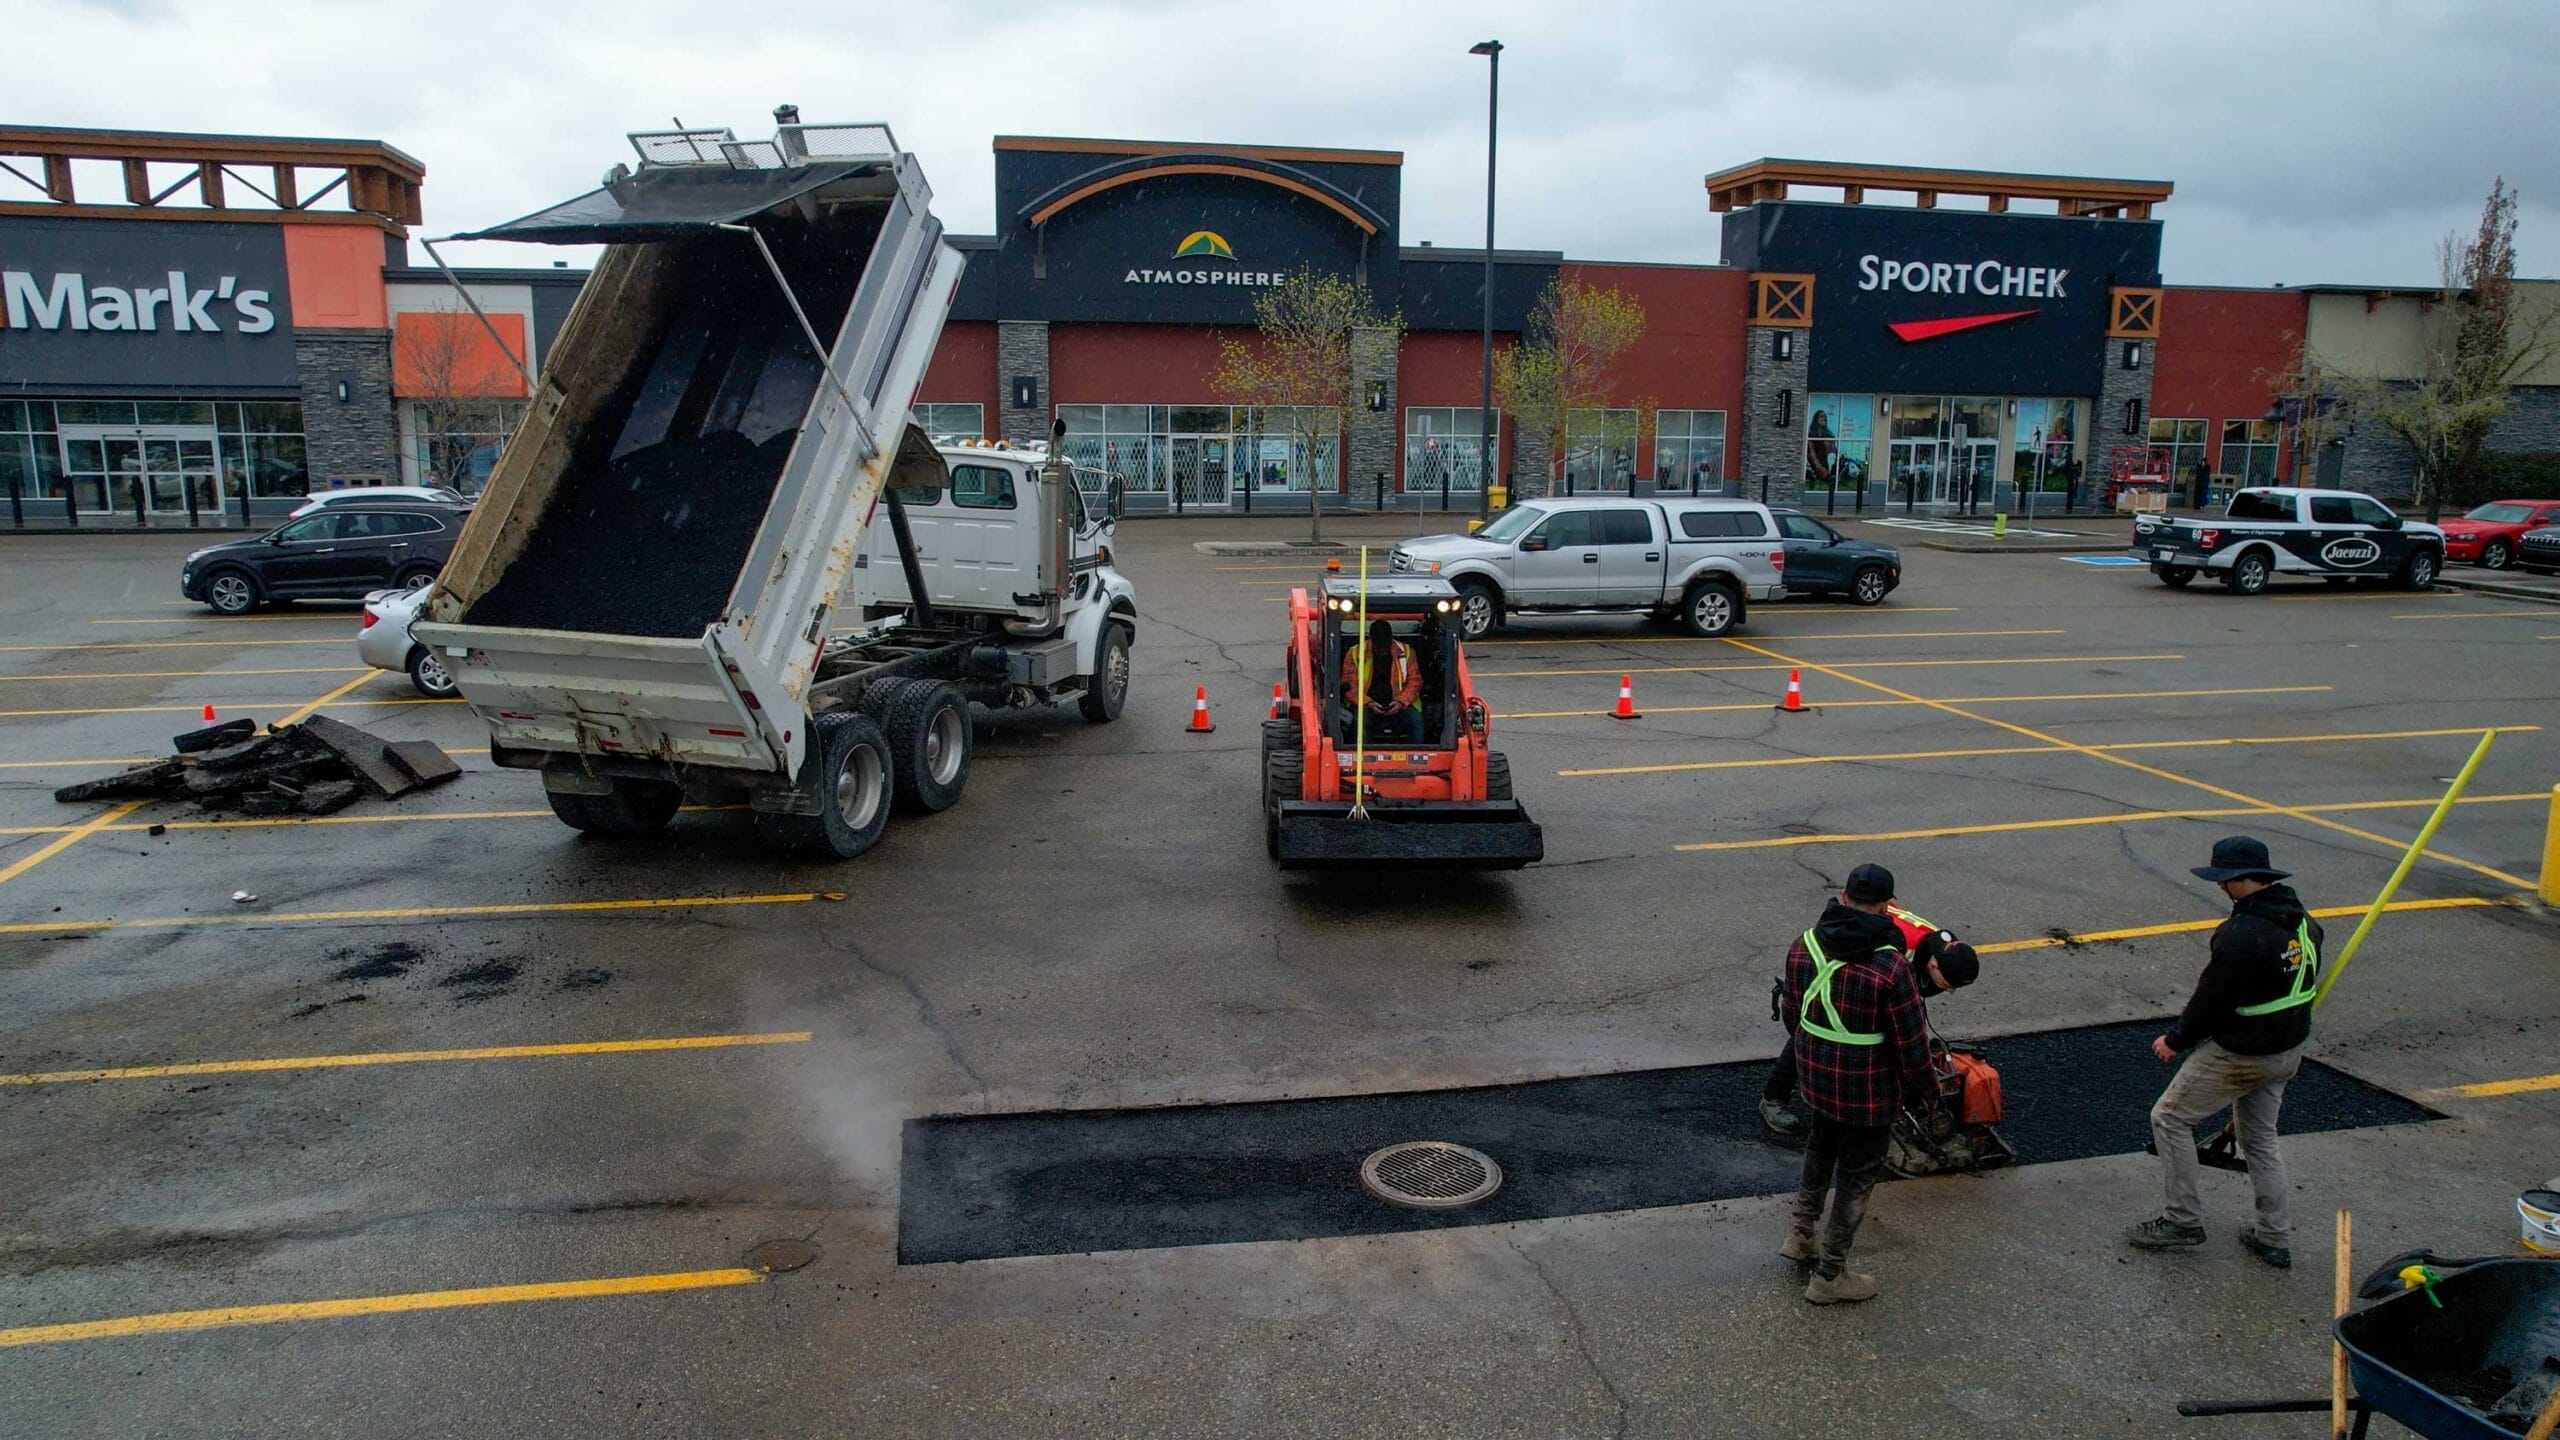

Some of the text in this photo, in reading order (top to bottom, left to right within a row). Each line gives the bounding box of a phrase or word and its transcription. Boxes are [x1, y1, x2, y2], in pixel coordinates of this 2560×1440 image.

[1124, 269, 1285, 287] ATMOSPHERE
[2, 271, 275, 334] Mark's
[2328, 545, 2374, 559] Jacuzzi
